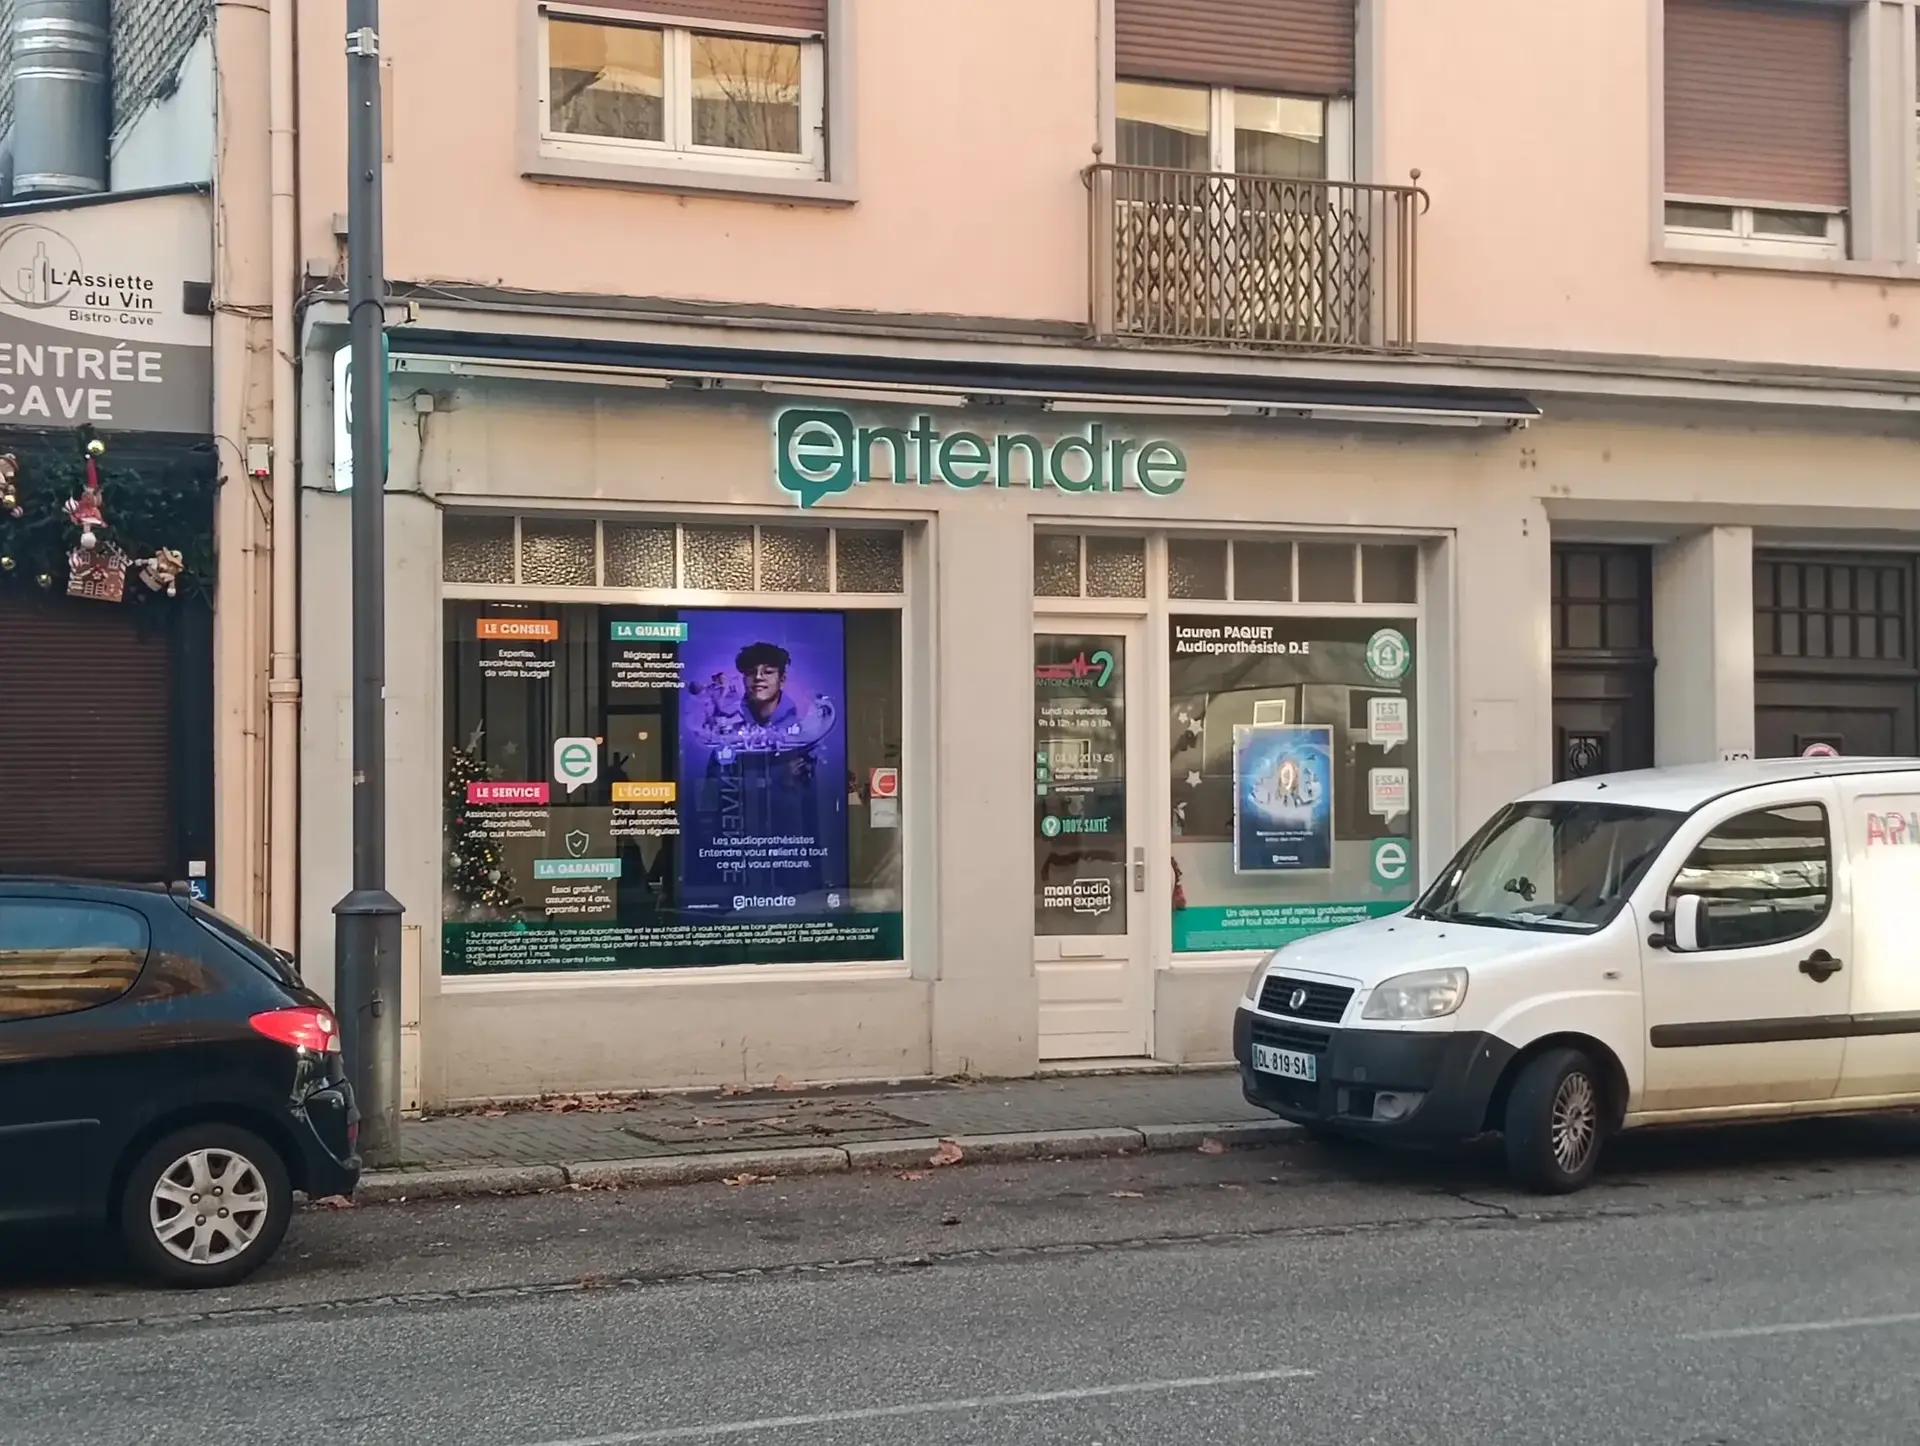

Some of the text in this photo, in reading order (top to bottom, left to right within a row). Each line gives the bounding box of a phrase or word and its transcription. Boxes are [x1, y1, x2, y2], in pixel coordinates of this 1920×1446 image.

[51, 268, 154, 290] L'Assiette
[85, 291, 153, 309] du Vin
[0, 383, 113, 420] CAVE
[779, 410, 1188, 498] entendre
[484, 623, 551, 635] LE CONSEIL
[617, 623, 681, 637] LA QUALITÉ
[1176, 625, 1273, 639] Lauren PAQUET
[1176, 640, 1309, 655] Audioprothésiste D.E
[623, 650, 660, 661] Réglages
[643, 661, 685, 669] innovation
[520, 670, 550, 679] budget
[611, 680, 685, 688] formation continue
[1041, 707, 1062, 716] Lundi
[1075, 707, 1108, 716] vendredi
[1375, 702, 1400, 715] TEST
[560, 744, 592, 778] e
[1375, 775, 1404, 786] ESSAI
[476, 787, 541, 798] LE SERVICE
[618, 785, 670, 797] L'ÉCOUTE
[464, 810, 507, 818] Assistance
[612, 807, 635, 816] Choix
[610, 818, 628, 826] suivi
[1062, 818, 1083, 833] 100%
[609, 827, 681, 837] contrôles réguliers
[712, 835, 814, 847] Les audioprothésistes
[699, 847, 828, 858] Entendre vous relient à tout
[716, 859, 812, 871] ce qui vous entoure.
[1375, 842, 1407, 879] e
[540, 863, 616, 875] LA GARANTIE
[551, 885, 571, 894] Essai
[545, 896, 587, 904] assurance
[733, 894, 796, 910] entendre
[545, 905, 580, 915] garantie
[1226, 905, 1367, 917] Un devis vous est remis gratuitement
[1221, 917, 1245, 927] avant
[1246, 917, 1262, 926] tout
[1263, 916, 1287, 925] achat
[1288, 916, 1300, 924] de
[1301, 915, 1330, 925] produit
